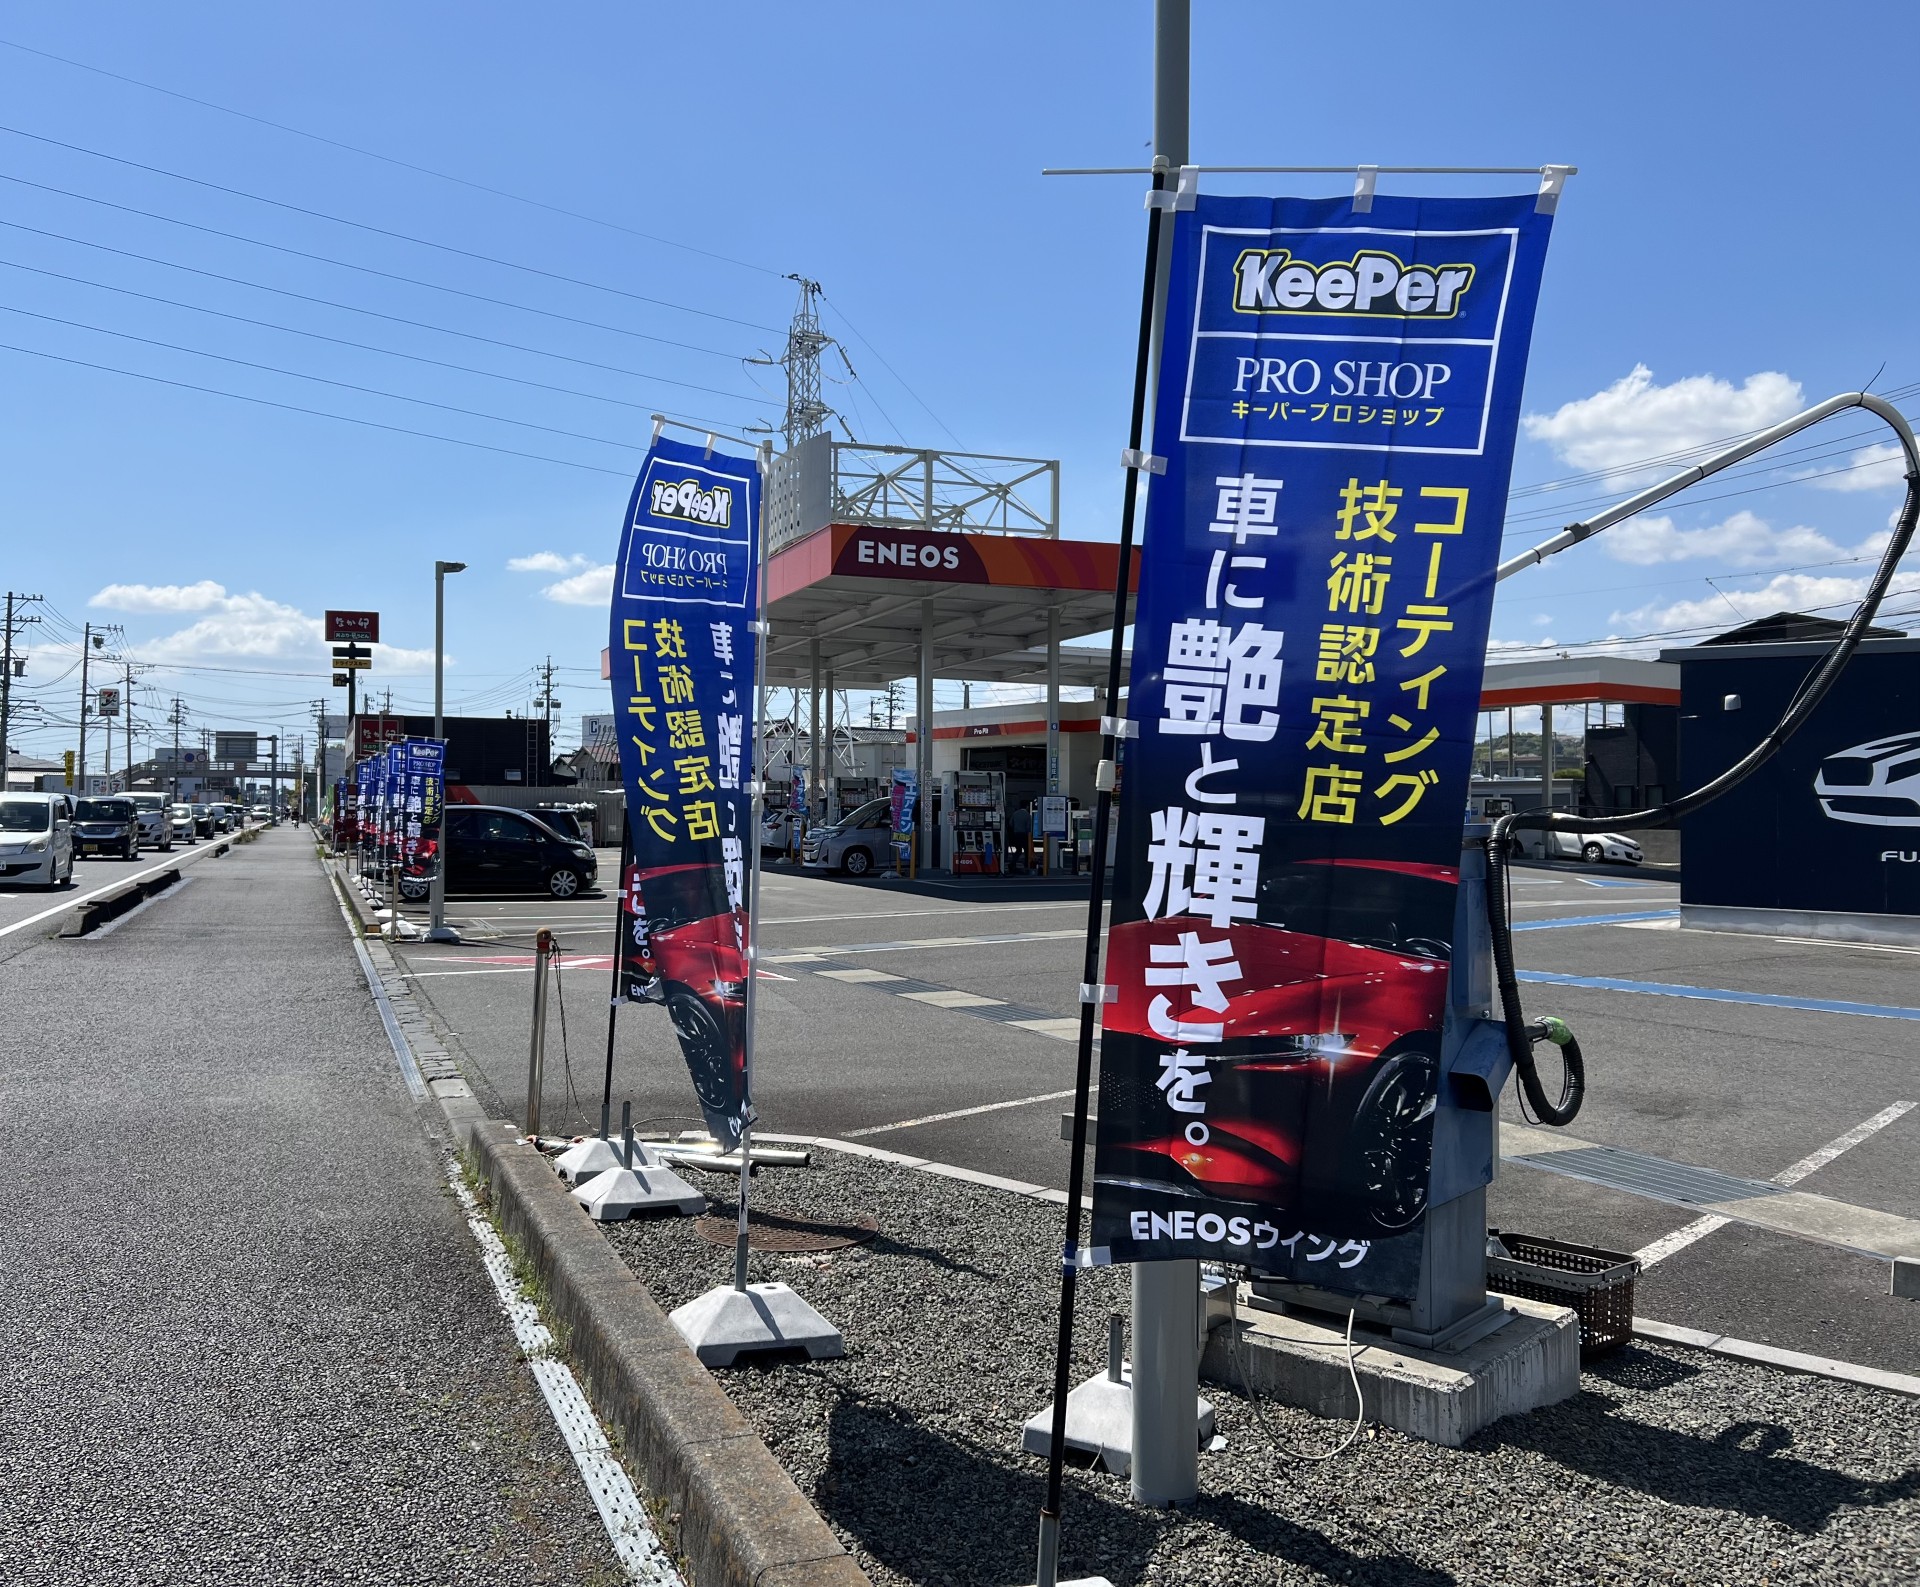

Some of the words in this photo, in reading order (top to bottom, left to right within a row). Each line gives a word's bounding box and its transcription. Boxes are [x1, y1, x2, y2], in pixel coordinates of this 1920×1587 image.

[1236, 251, 1473, 316] KeePer
[1232, 356, 1321, 395] PRO
[1331, 360, 1451, 399] SHOP
[1231, 400, 1444, 426] キーパープロショップ
[858, 540, 959, 570] ENEOS
[1297, 477, 1403, 824] 技術認定店
[1373, 486, 1470, 826] コーティング
[1143, 473, 1284, 1147] 車に艶と輝きを。
[1881, 850, 1920, 863] FU
[1130, 1210, 1371, 1269] ENEOSウイング
